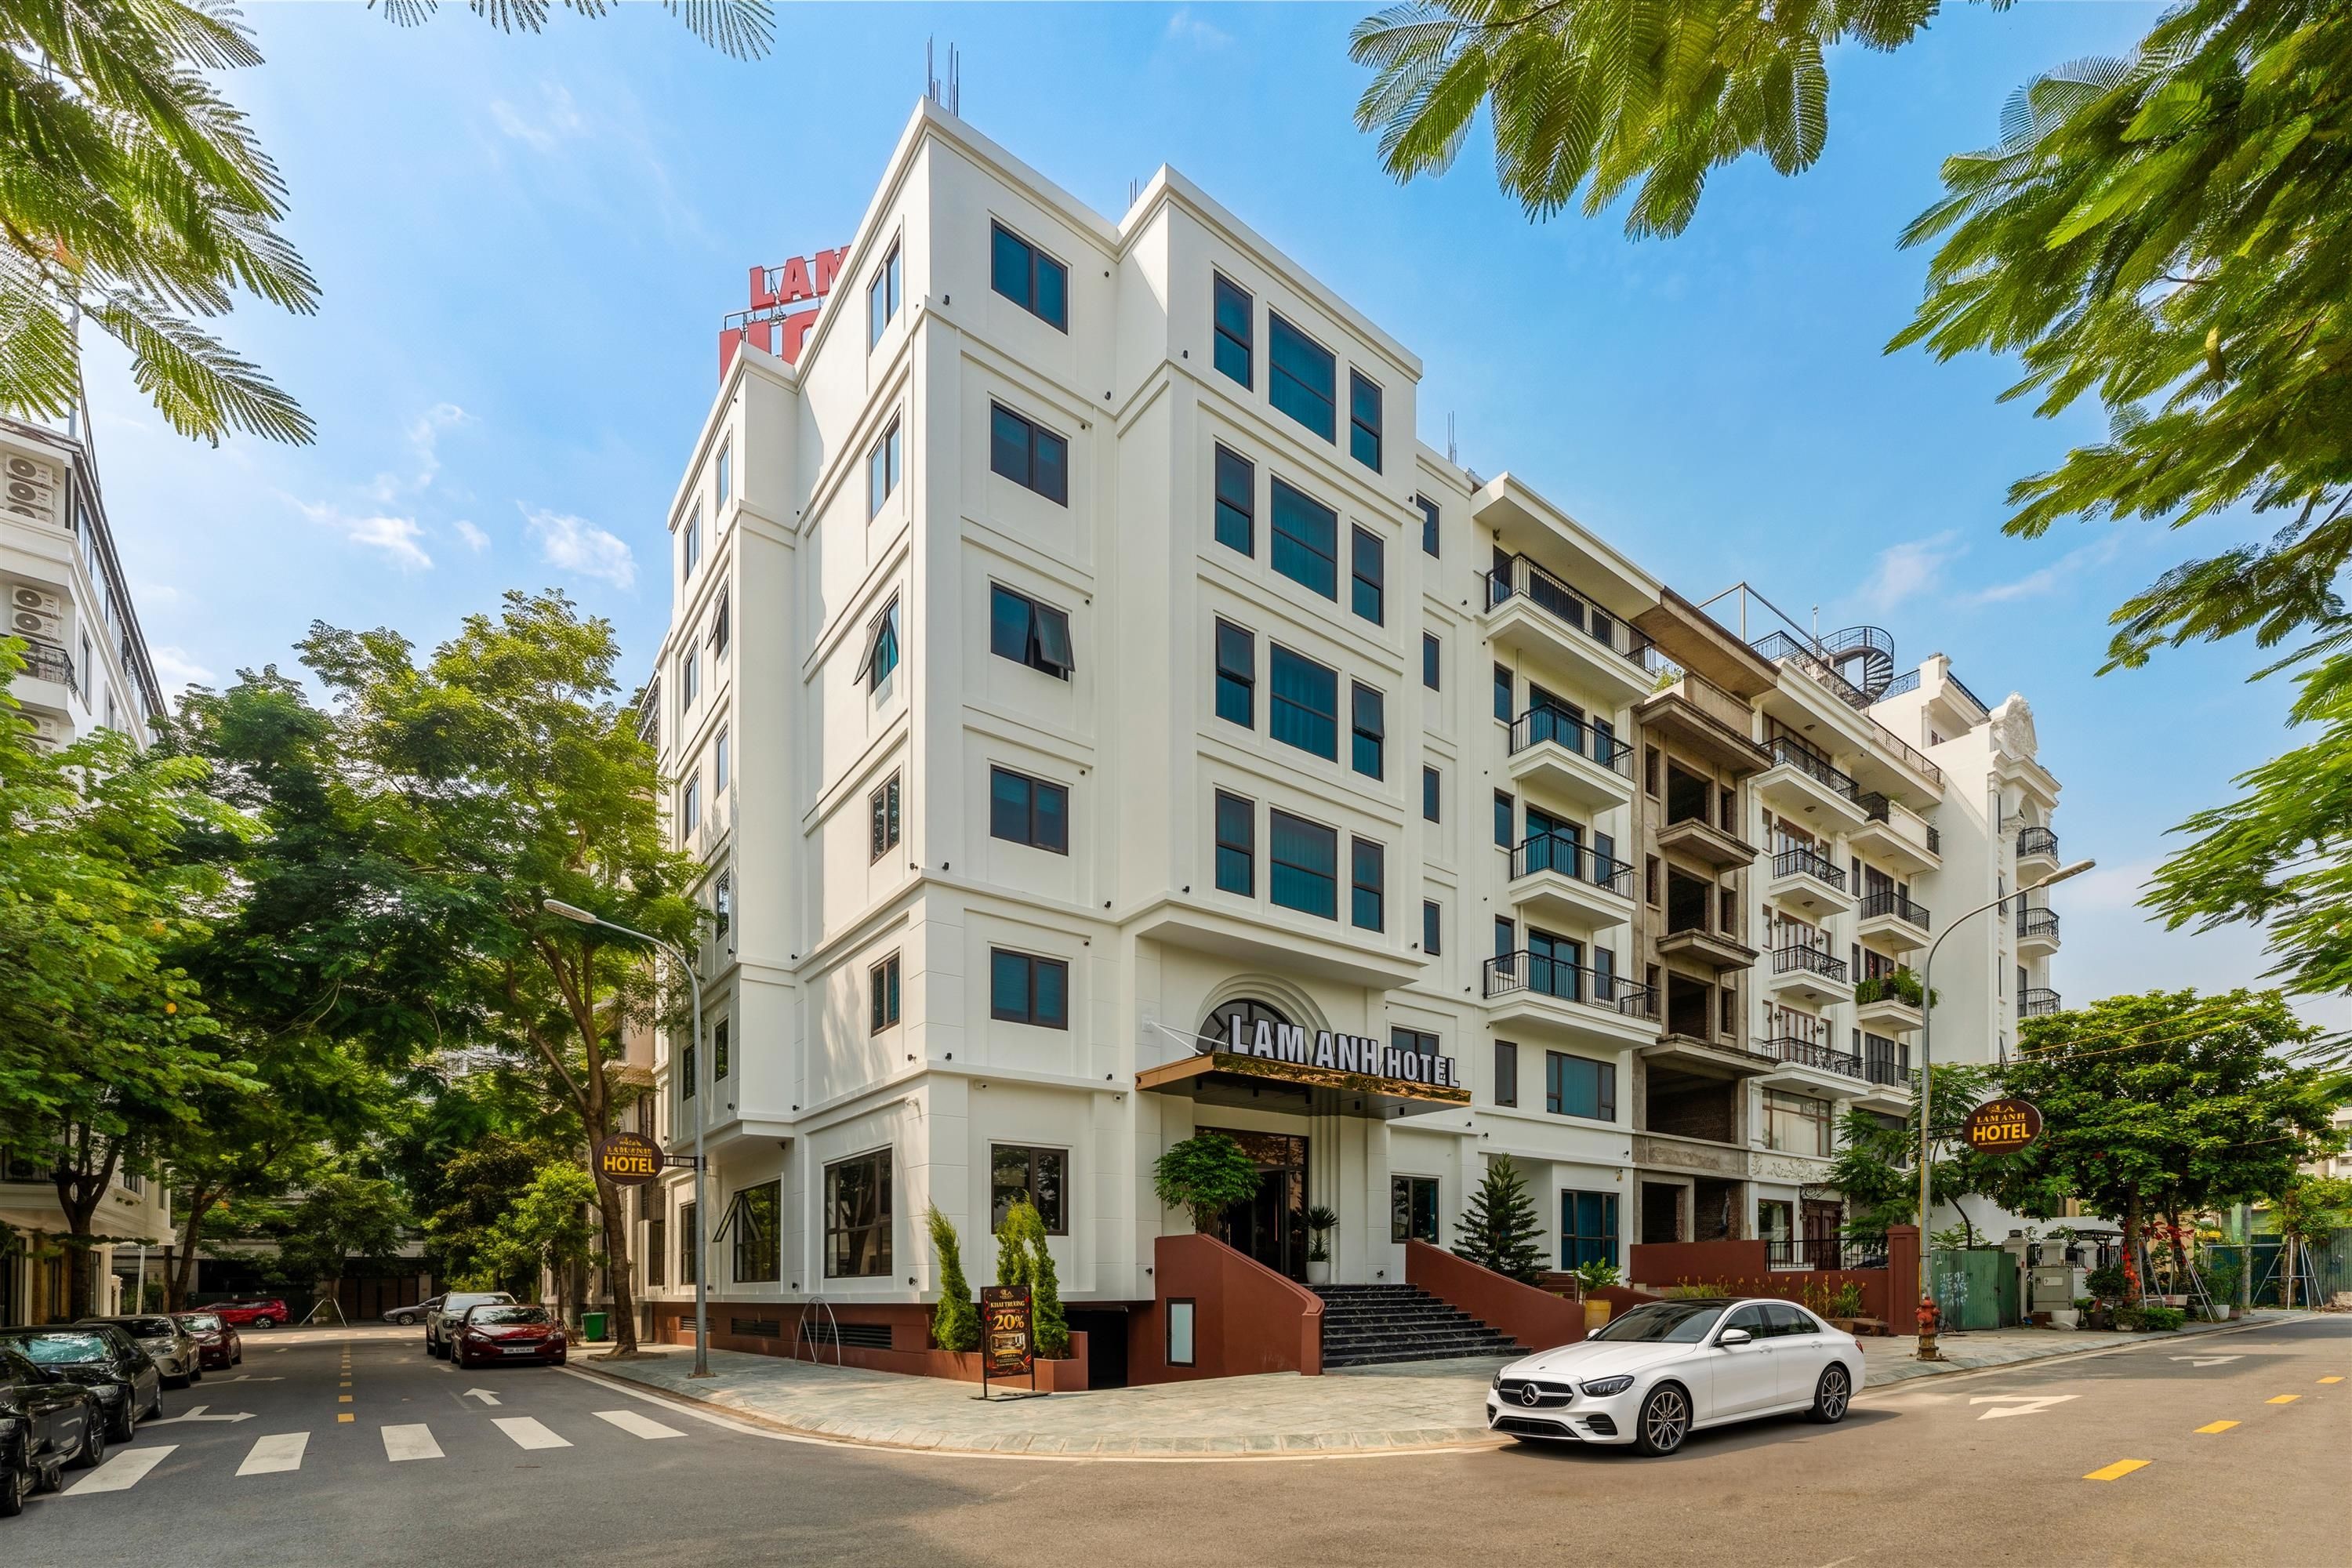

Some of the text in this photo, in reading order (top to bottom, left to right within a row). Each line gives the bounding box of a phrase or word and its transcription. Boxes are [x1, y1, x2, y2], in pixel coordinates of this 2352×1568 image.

[1229, 1014, 1461, 1089] LAM ANH HOTEL
[1973, 1123, 2031, 1142] HOTEL
[604, 1156, 655, 1173] HOTEL
[993, 1314, 1025, 1330] 20%
